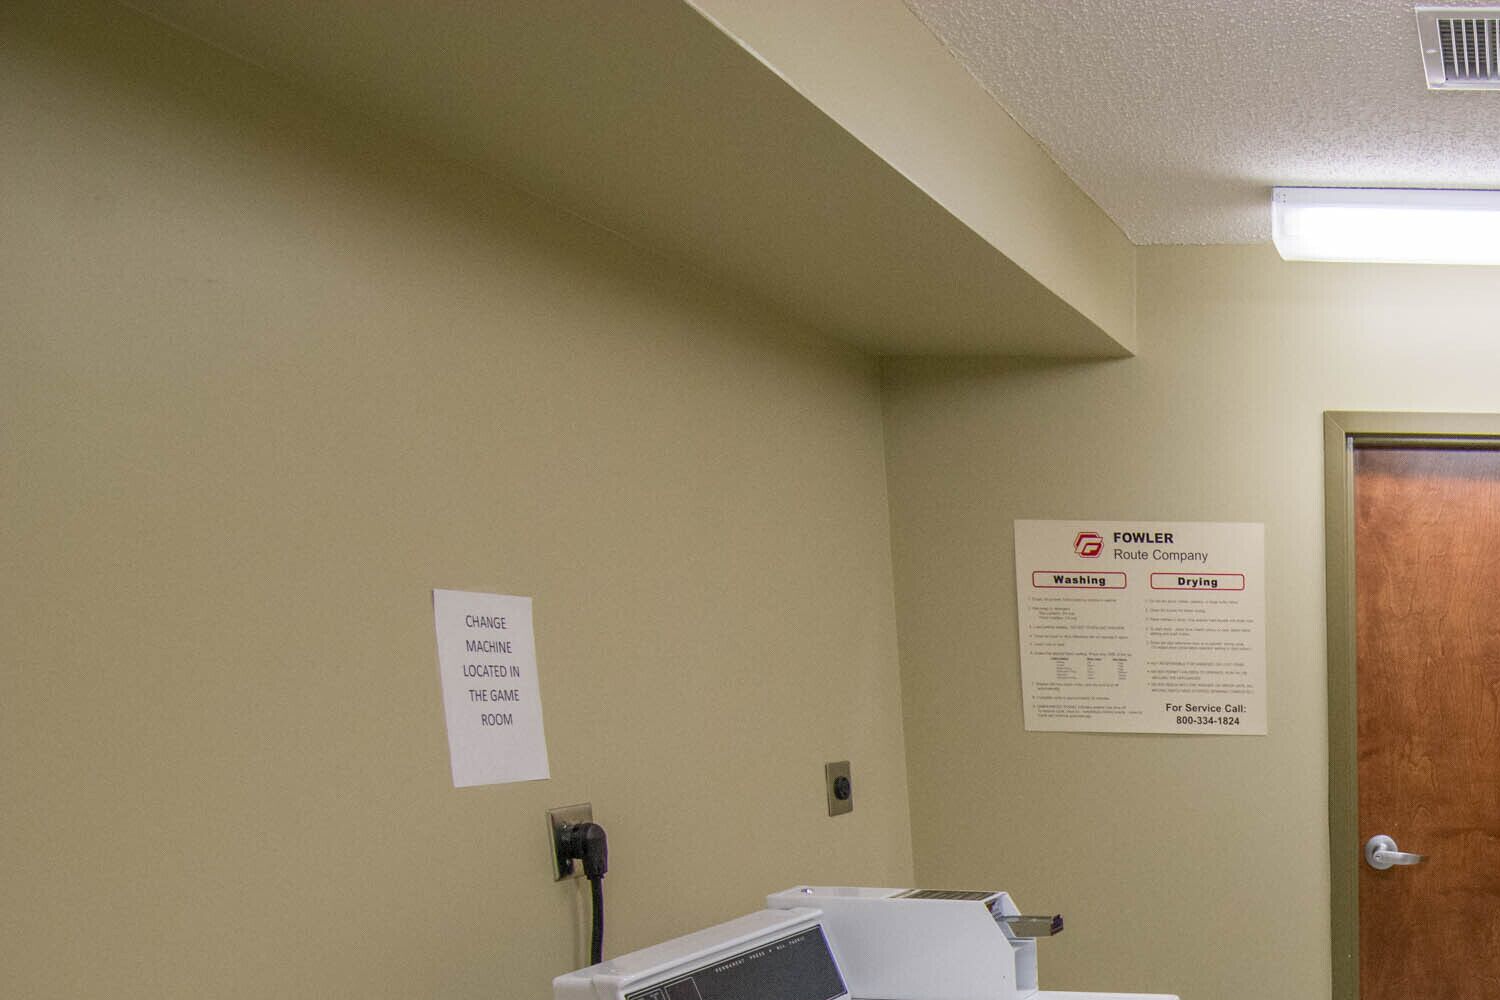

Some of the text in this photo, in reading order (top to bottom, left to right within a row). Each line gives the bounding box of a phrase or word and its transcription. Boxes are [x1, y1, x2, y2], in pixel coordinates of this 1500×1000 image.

[1113, 532, 1174, 544] FOWLER
[1113, 549, 1209, 563] Route Company
[1053, 575, 1107, 587] Washing
[1177, 577, 1218, 588] Drying
[465, 614, 507, 629] CHANGE
[466, 639, 512, 654] MACHINE
[463, 664, 520, 678] LOCATED IN
[468, 689, 520, 702] THE GAME
[1165, 703, 1247, 713] For Service Call:
[481, 713, 513, 726] ROOM
[1176, 715, 1240, 725] 800-334-1824
